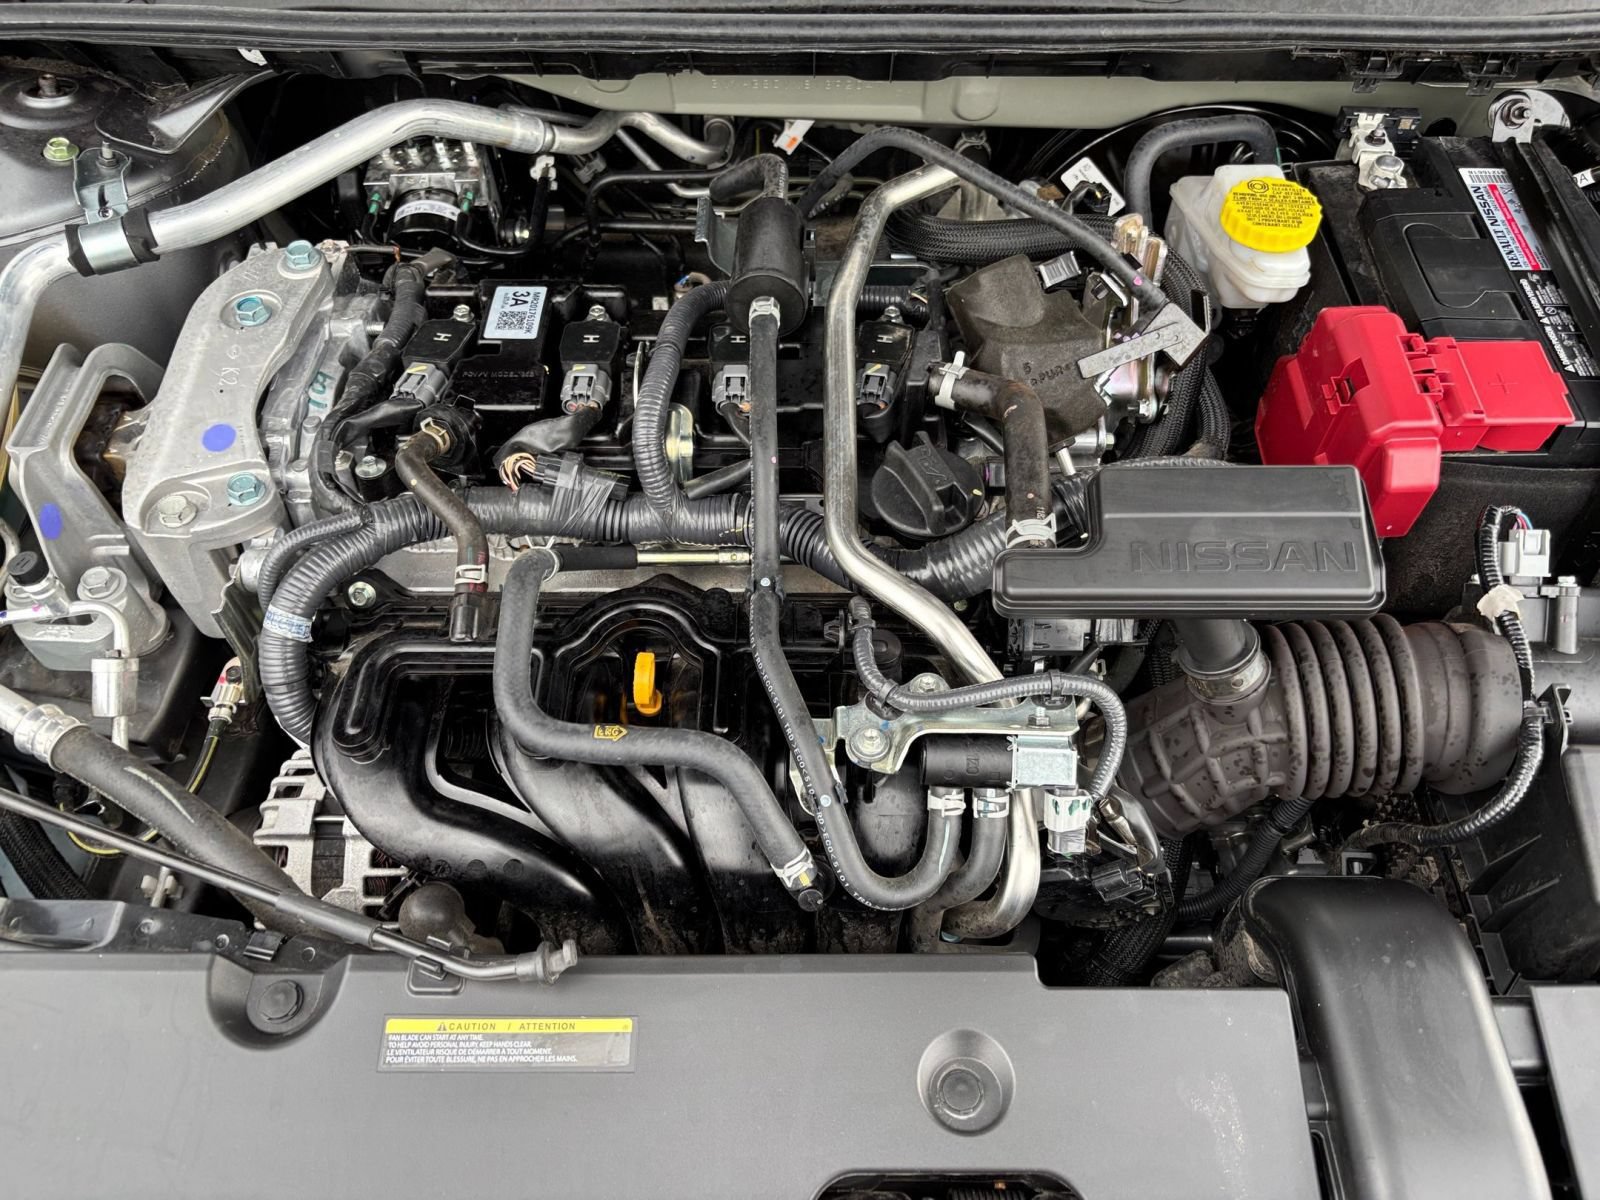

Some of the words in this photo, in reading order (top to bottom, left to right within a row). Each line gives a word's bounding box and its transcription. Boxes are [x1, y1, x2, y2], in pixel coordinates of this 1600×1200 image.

[1471, 186, 1500, 226] NISSAN
[1494, 229, 1522, 268] RENAULT
[510, 290, 530, 307] 3A
[433, 332, 452, 342] H
[583, 334, 600, 343] H
[730, 335, 746, 343] H
[876, 334, 893, 343] H
[1130, 539, 1359, 573] NISSAN
[449, 1022, 496, 1031] CAUTION
[520, 1022, 576, 1031] ATTENTION
[386, 1055, 403, 1063] POUR
[426, 1055, 445, 1063] TOUTE
[478, 1055, 486, 1063] NE
[487, 1055, 498, 1063] PAS
[499, 1055, 508, 1063] EN
[508, 1055, 544, 1063] APPROCHER
[545, 1055, 556, 1063] LES
